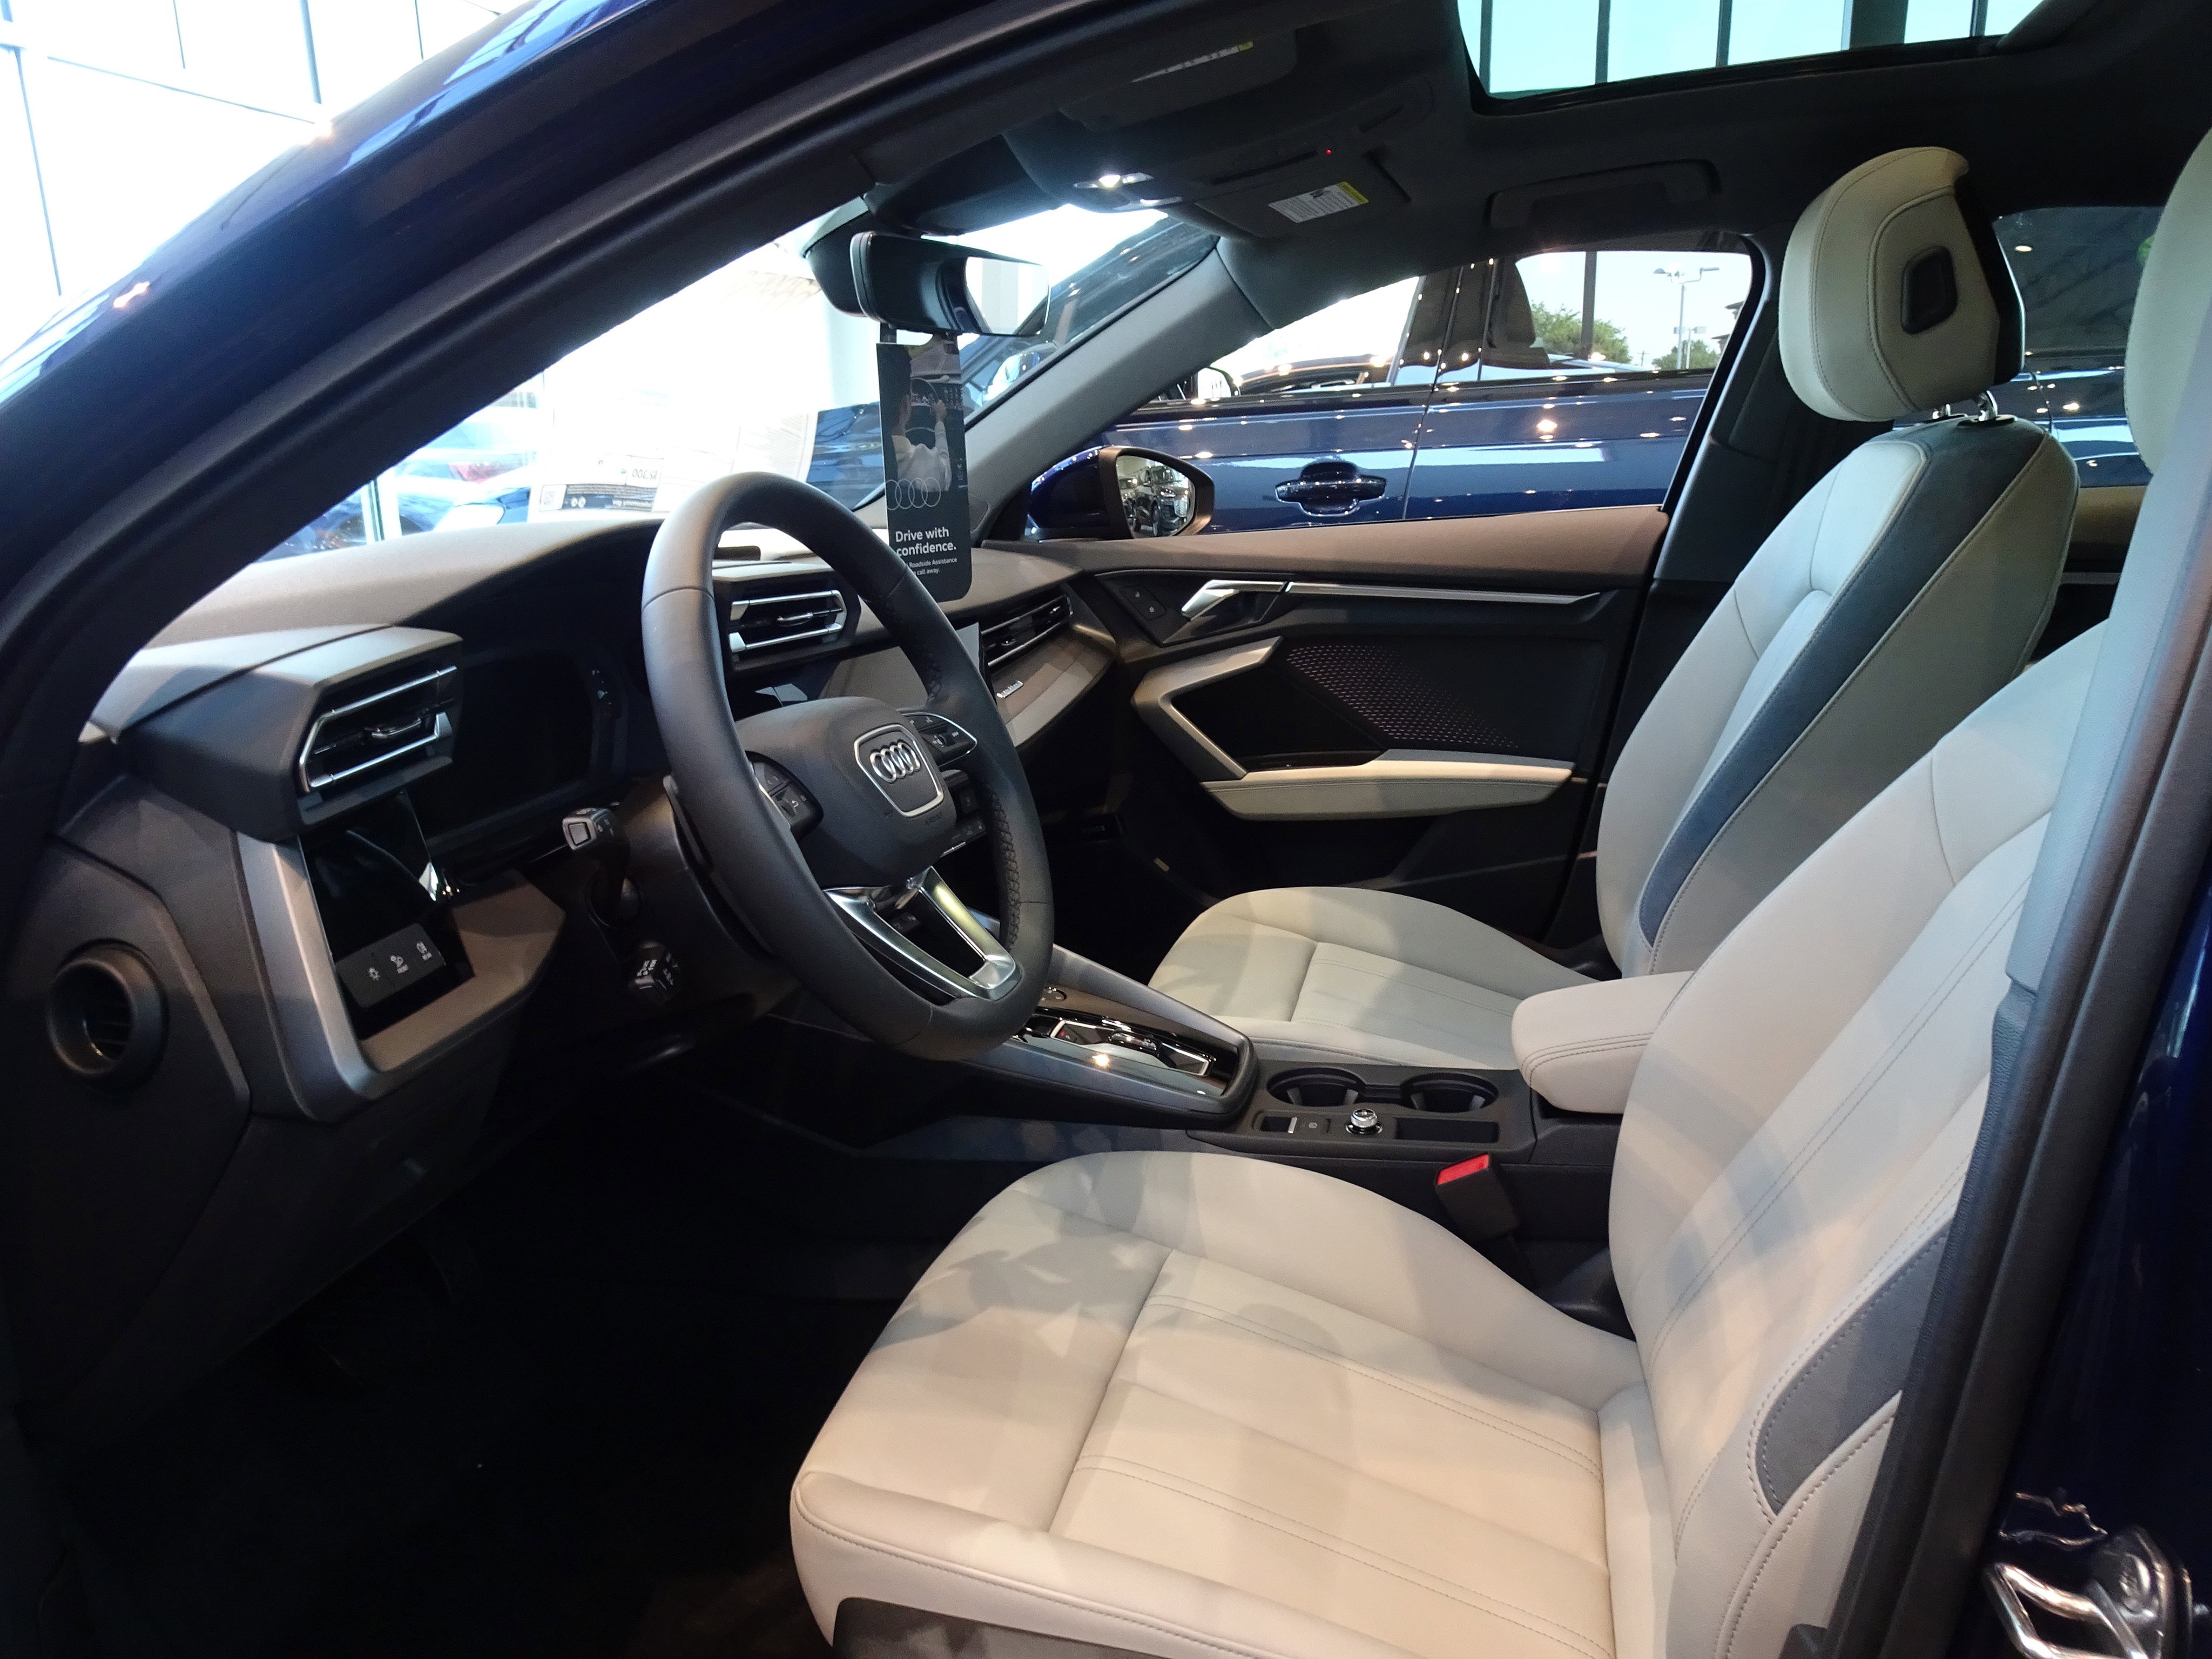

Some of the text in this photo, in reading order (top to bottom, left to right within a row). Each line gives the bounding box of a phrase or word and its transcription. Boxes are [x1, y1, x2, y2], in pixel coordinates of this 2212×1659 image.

[895, 527, 949, 542] Drive with
[896, 542, 956, 557] confidence.
[909, 560, 931, 568] Roadside
